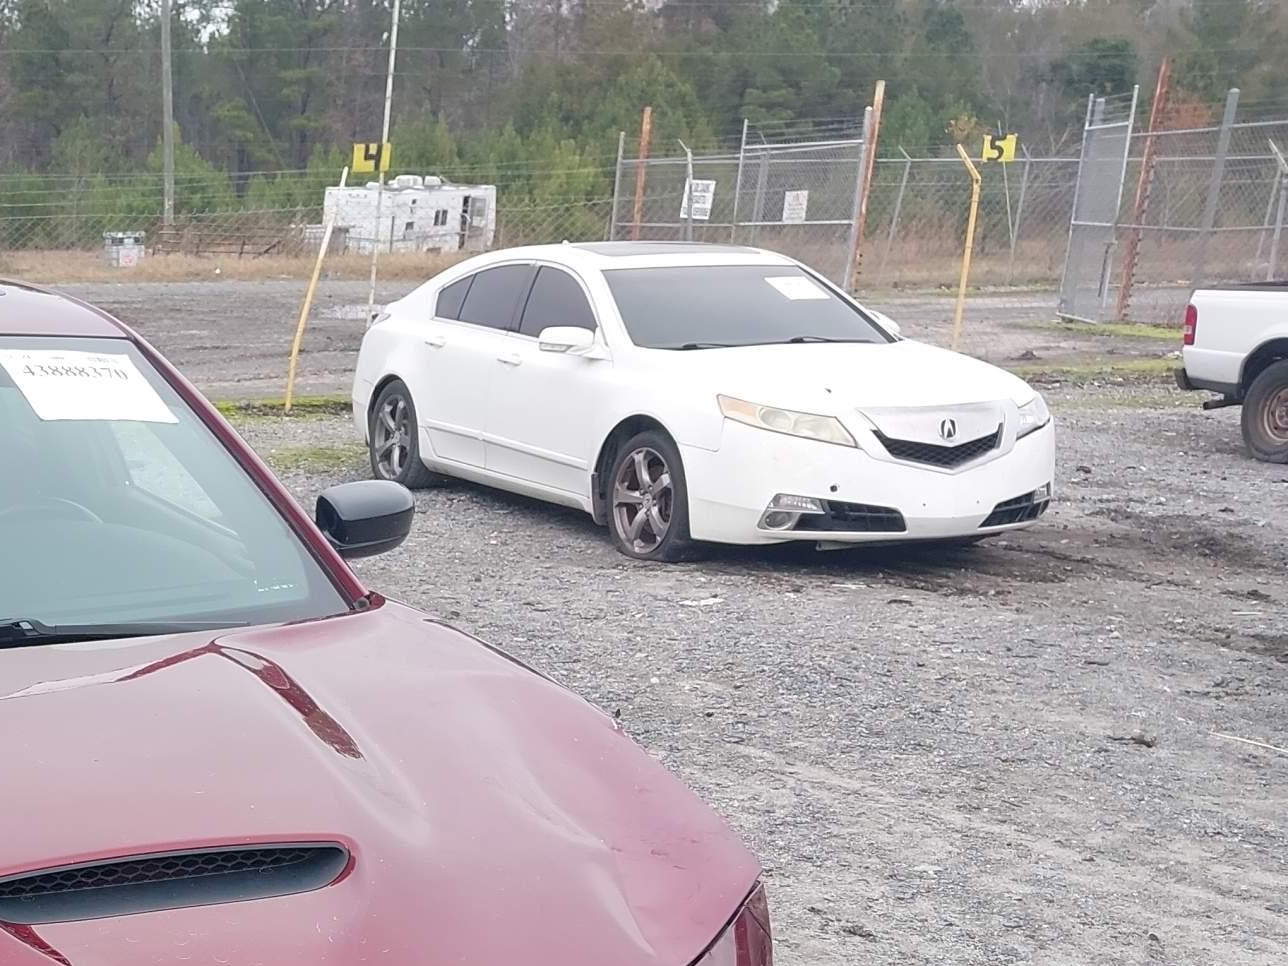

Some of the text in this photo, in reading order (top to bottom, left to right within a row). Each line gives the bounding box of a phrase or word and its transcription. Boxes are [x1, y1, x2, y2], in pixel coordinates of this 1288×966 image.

[364, 143, 383, 171] 4
[987, 134, 1008, 161] 5
[23, 364, 129, 380] 43888370
